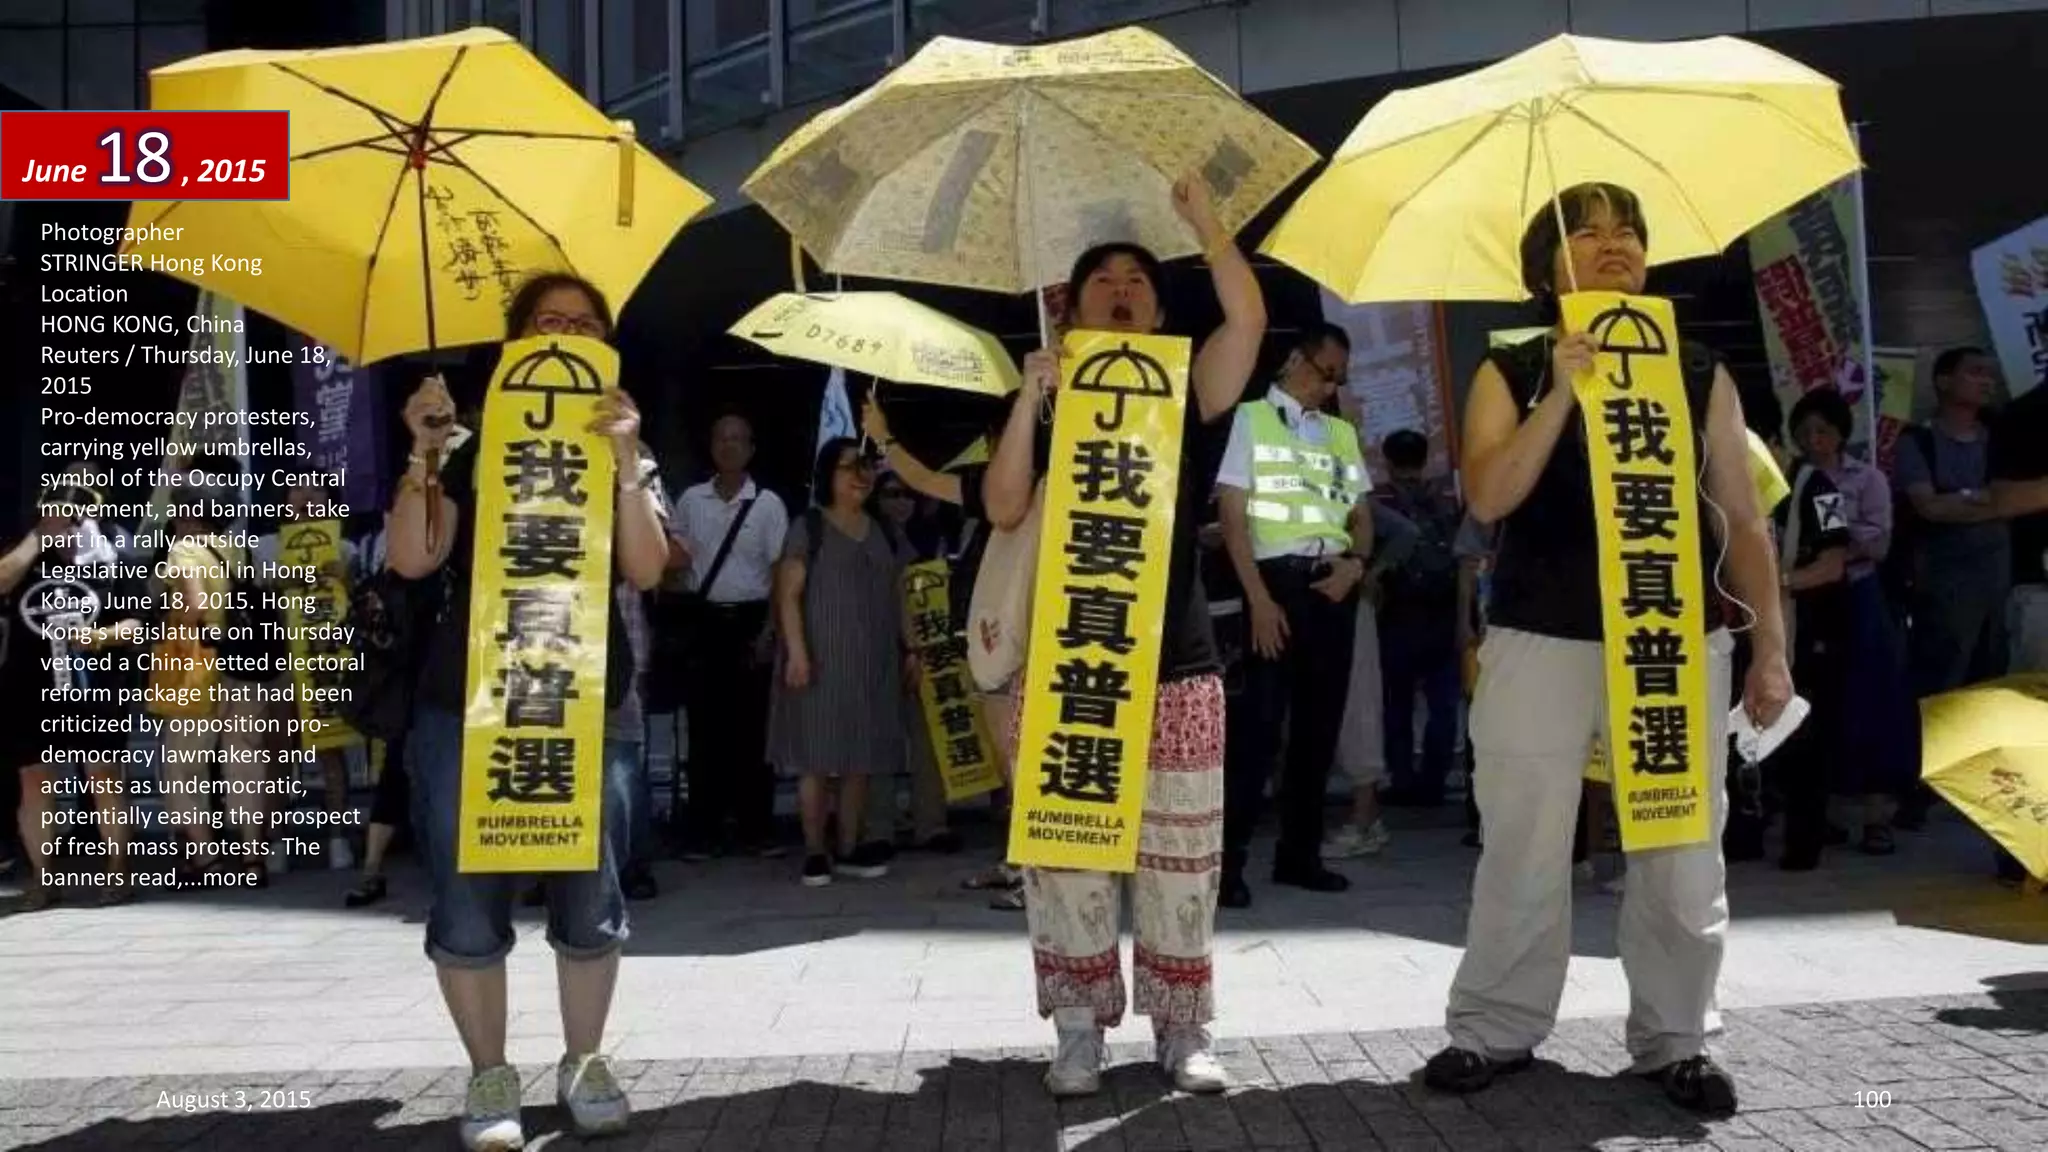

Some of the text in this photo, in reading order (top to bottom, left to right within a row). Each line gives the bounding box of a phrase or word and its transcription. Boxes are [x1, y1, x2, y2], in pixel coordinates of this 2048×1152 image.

[1602, 397, 1689, 777] 我要真普選
[486, 439, 588, 804] 我要真普選
[1039, 439, 1153, 804] 我要真普選
[477, 815, 584, 828] #UMBRELLA
[1027, 809, 1125, 829] #UMBRELLA
[480, 832, 579, 846] MOVEMENT
[1028, 827, 1121, 846] MOVEMENT
